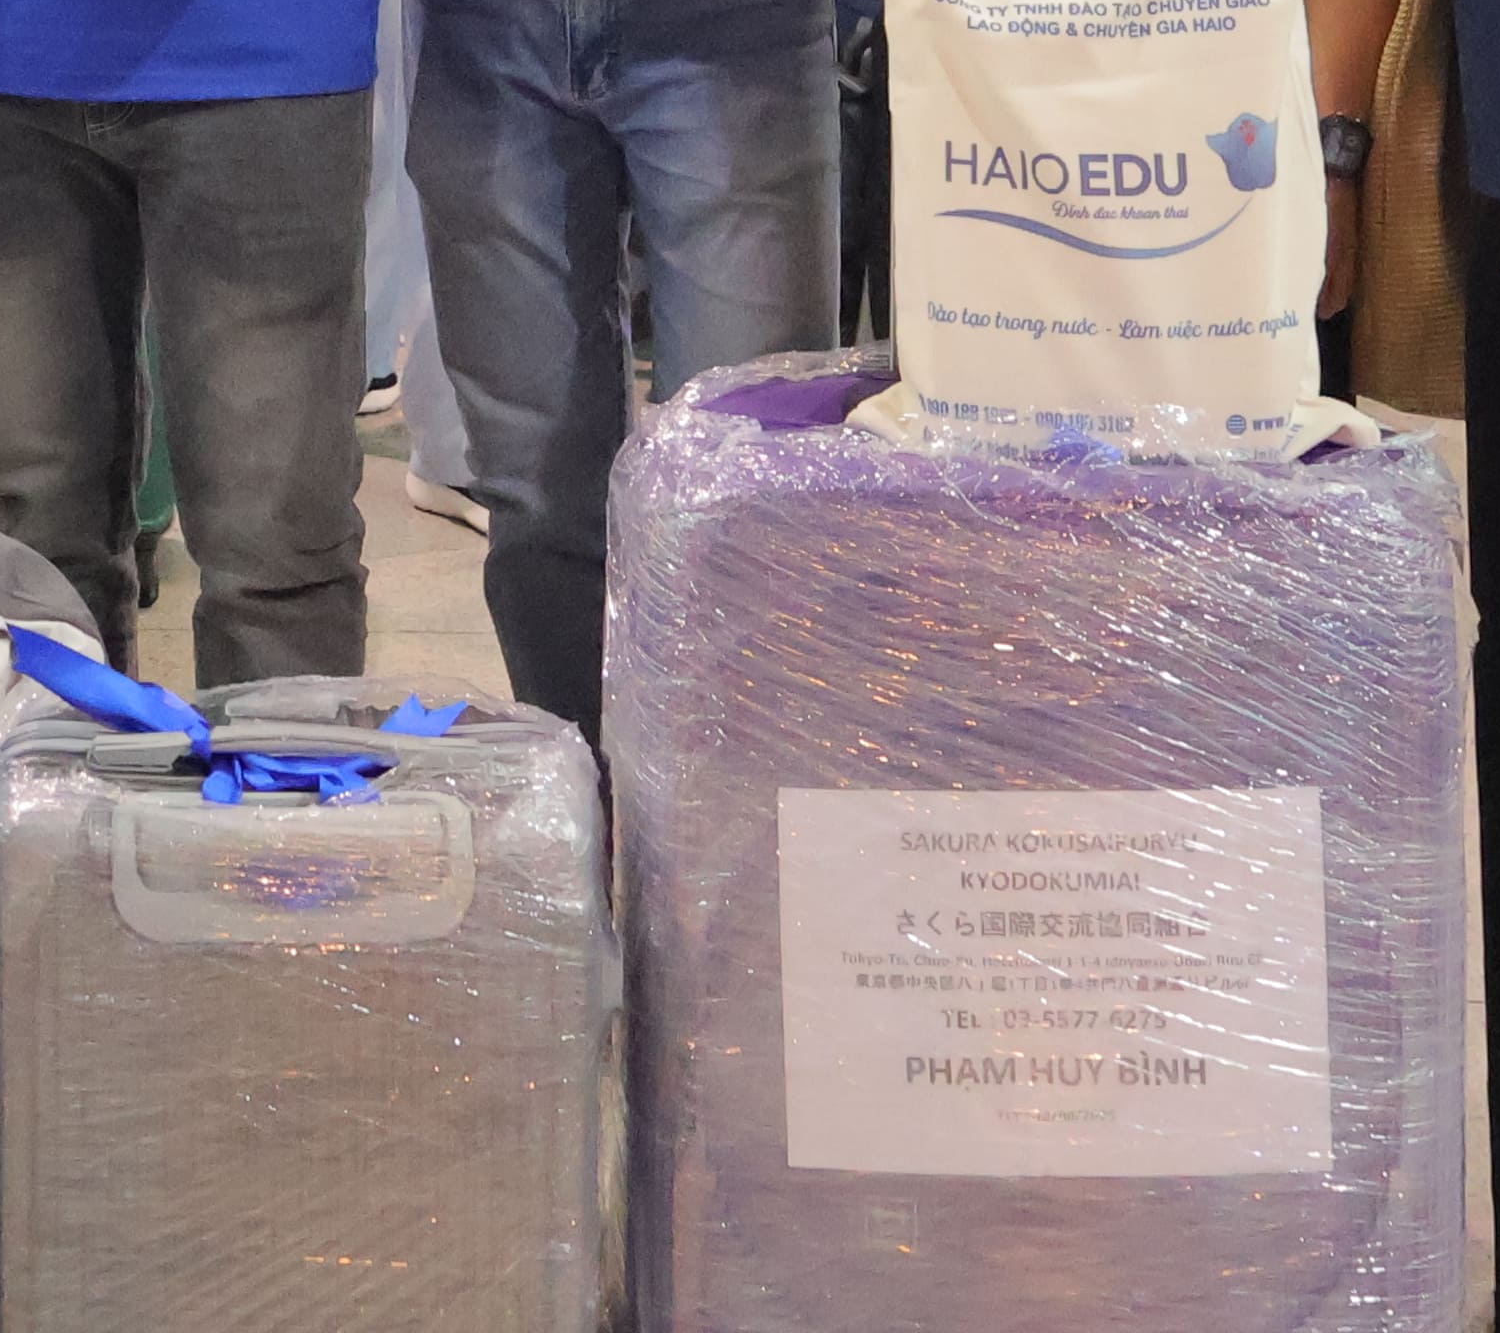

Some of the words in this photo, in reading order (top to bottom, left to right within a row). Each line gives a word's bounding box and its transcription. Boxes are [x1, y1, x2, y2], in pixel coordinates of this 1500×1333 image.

[987, 5, 1008, 17] TY
[1014, 3, 1063, 15] TNHH
[1068, 0, 1108, 16] ĐÀO
[967, 16, 1003, 33] LAO
[1065, 22, 1078, 37] &
[1156, 19, 1188, 34] GIA
[1192, 16, 1236, 32] HAIO
[945, 140, 1069, 195] HAIO
[1079, 152, 1188, 197] EDU
[995, 311, 1047, 340] trong
[1118, 319, 1161, 340] Làm
[901, 832, 998, 853] SAKURA
[941, 1009, 982, 1029] TEL
[905, 1056, 1017, 1092] PHẠM
[1030, 1057, 1104, 1087] HUY
[1118, 1051, 1208, 1087] BÌNH
